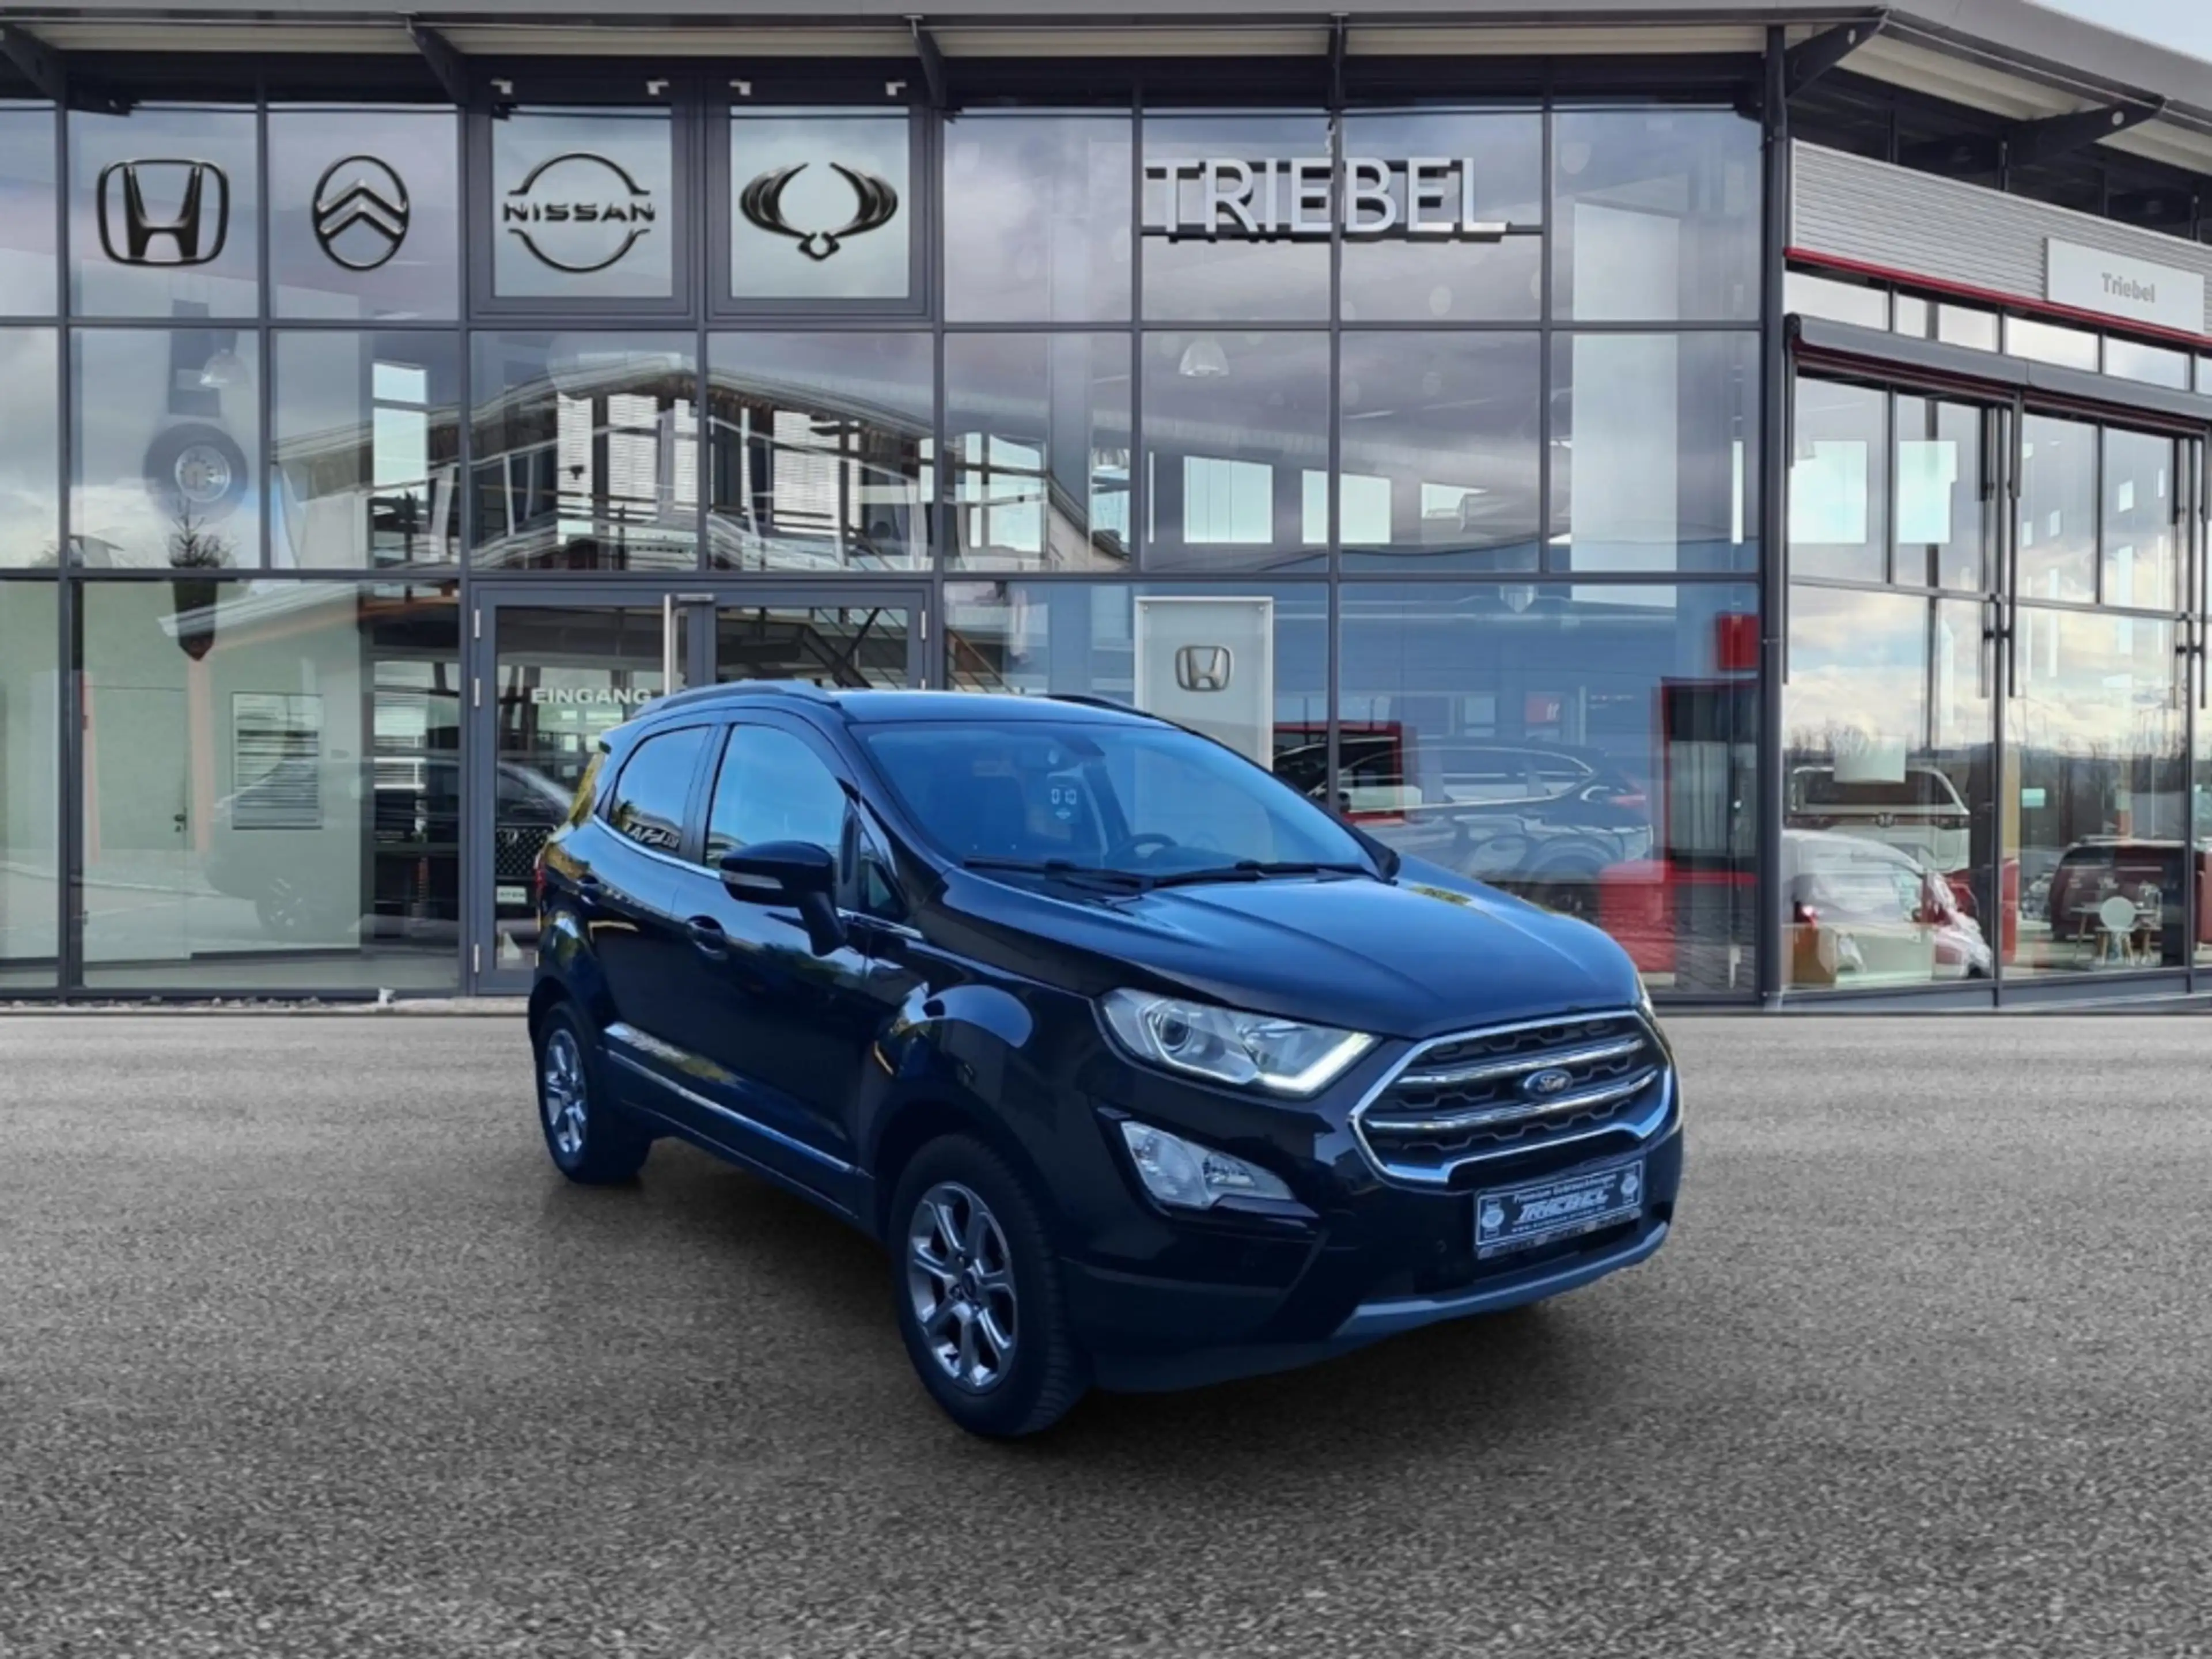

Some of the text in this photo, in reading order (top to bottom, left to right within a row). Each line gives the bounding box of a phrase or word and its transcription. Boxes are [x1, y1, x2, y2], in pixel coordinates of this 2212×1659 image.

[1144, 157, 1506, 234] TRIEBEL
[503, 202, 656, 222] NISSAN
[2101, 272, 2156, 304] Triebel
[531, 688, 652, 704] EINGANG
